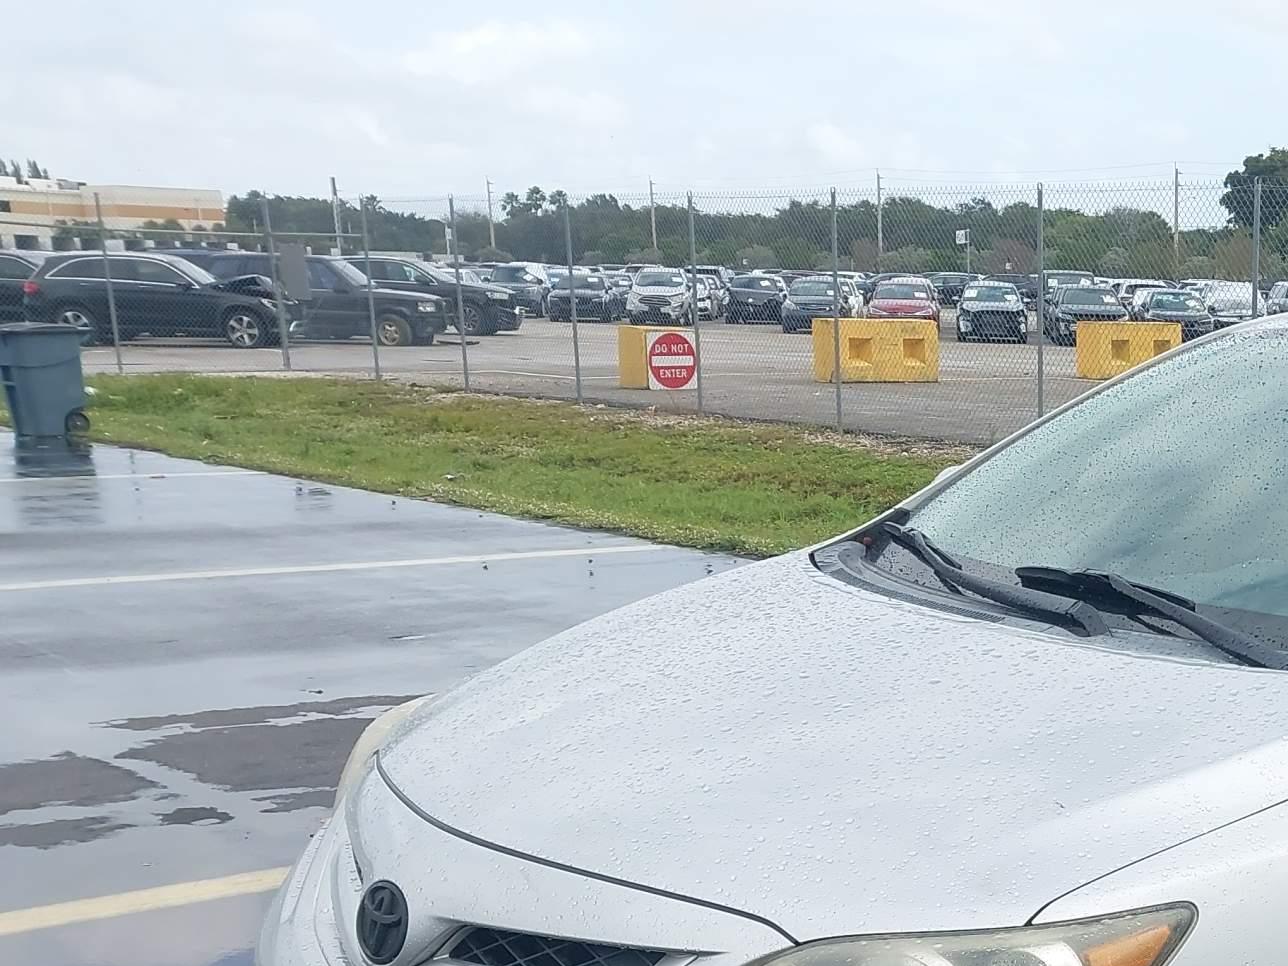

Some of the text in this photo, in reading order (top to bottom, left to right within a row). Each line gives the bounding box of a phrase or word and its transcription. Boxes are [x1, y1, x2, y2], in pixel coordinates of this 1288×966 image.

[655, 344, 689, 353] DO NOT
[660, 369, 687, 378] ENTER
